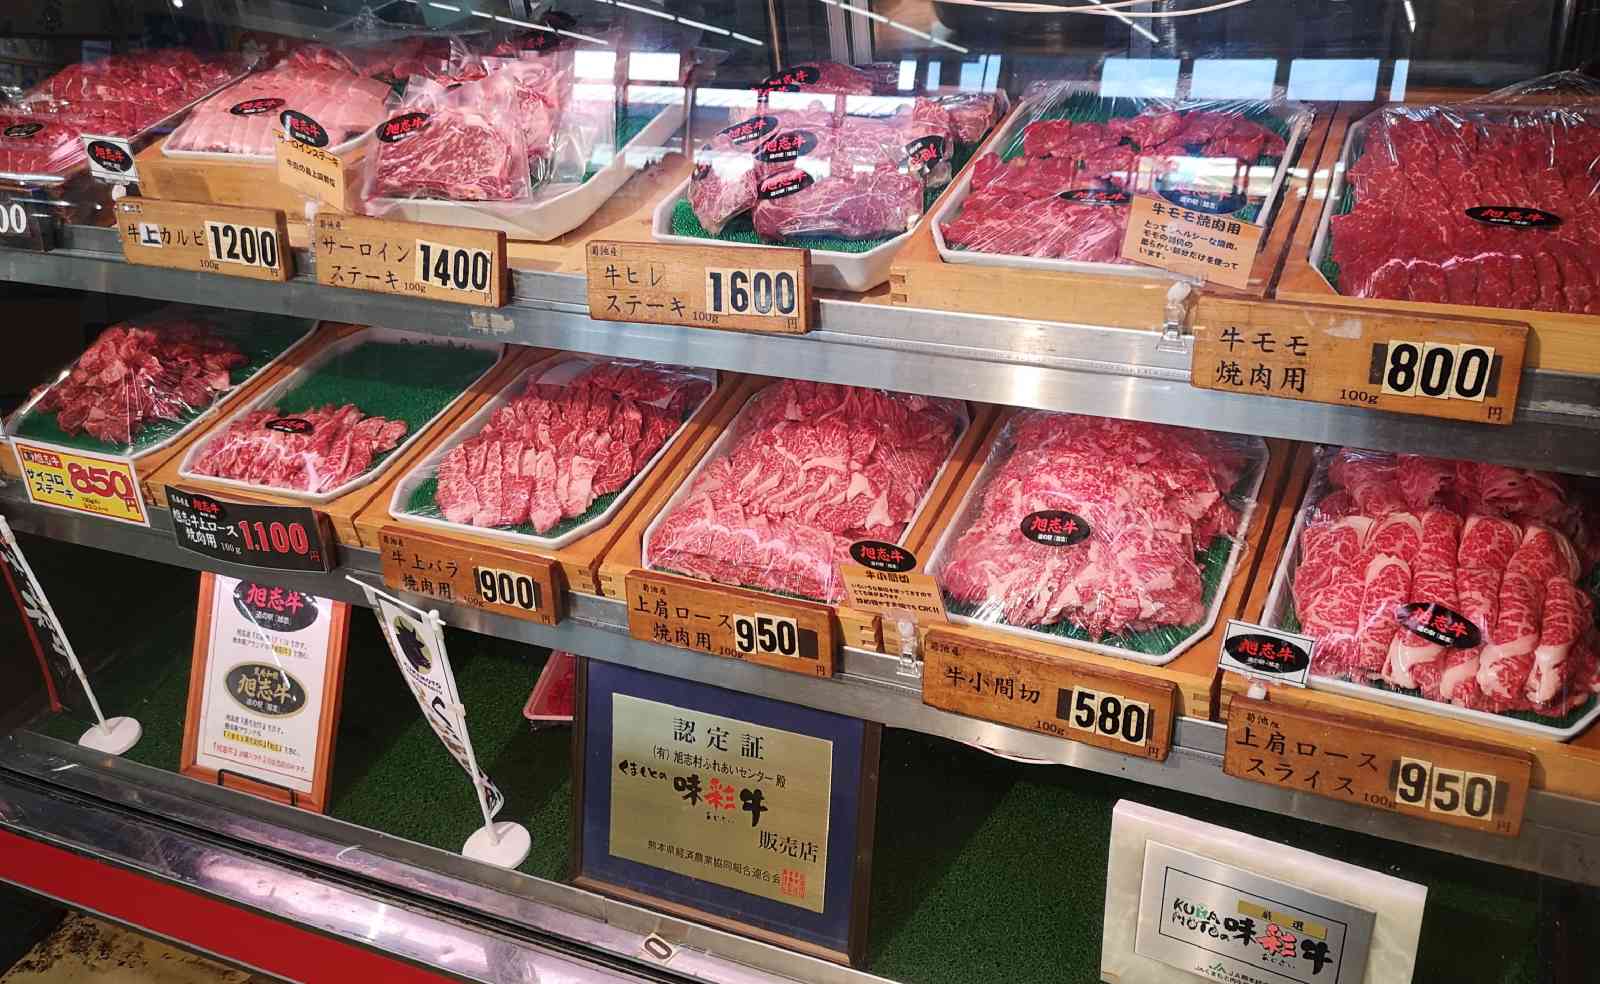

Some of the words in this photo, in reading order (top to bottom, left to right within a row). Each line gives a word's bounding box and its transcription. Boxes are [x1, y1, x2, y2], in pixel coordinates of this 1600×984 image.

[1152, 202, 1241, 235] 牛モモ焼肉用
[127, 222, 204, 247] 牛上カルビ
[209, 224, 278, 268] 1200
[323, 235, 410, 263] サーロイン
[330, 265, 400, 290] ステーキ
[420, 244, 490, 291] 1400
[604, 264, 663, 288] 牛ヒレ
[404, 281, 427, 294] 100g
[709, 270, 796, 314] 1600
[606, 294, 687, 318] ステーキ
[692, 311, 720, 325] 100g
[786, 317, 799, 330] 円
[1218, 326, 1310, 358] 牛モモ
[1215, 360, 1308, 394] 焼肉用
[1386, 343, 1491, 399] 800
[1339, 387, 1380, 405] 100g
[1486, 405, 1504, 421] 円
[25, 468, 66, 487] サイコロ
[35, 481, 75, 500] ステーキ
[67, 461, 136, 501] 850
[172, 508, 240, 538] 旭志牛上ロース
[1030, 515, 1079, 535] 旭志牛
[186, 527, 218, 549] 焼肉用
[392, 551, 459, 578] 牛上バラ
[861, 546, 904, 562] 旭志牛
[402, 574, 453, 599] 焼肉用
[480, 569, 535, 611] 900
[865, 569, 910, 584] 牛小間切
[245, 583, 305, 615] 旭志牛
[634, 595, 734, 632] 上肩ロース
[652, 622, 713, 651] 焼肉用
[735, 617, 797, 657] 950
[1407, 607, 1468, 638] 旭志牛
[1237, 638, 1295, 663] 旭志牛
[815, 663, 826, 677] 円
[237, 673, 292, 704] 旭志牛
[946, 665, 1041, 705] 牛小間切
[1034, 718, 1066, 737] 100g
[1075, 690, 1144, 743] 580
[672, 716, 765, 761] 認定証
[1235, 726, 1380, 774] 上肩ロース
[618, 759, 668, 782] くまもとの
[672, 751, 773, 783] 旭志村ふれあいセンター
[775, 773, 787, 790] 殿
[1246, 757, 1357, 797] スライス
[673, 773, 769, 828] 味彩牛
[1363, 792, 1399, 811] 100g
[1398, 762, 1494, 819] 950
[1496, 819, 1512, 834] 円
[759, 829, 819, 864] 販売店
[648, 839, 781, 885] 熊本県経済農業協同組合連合会
[1172, 897, 1221, 925] KUMA
[1223, 916, 1334, 976] 味彩牛
